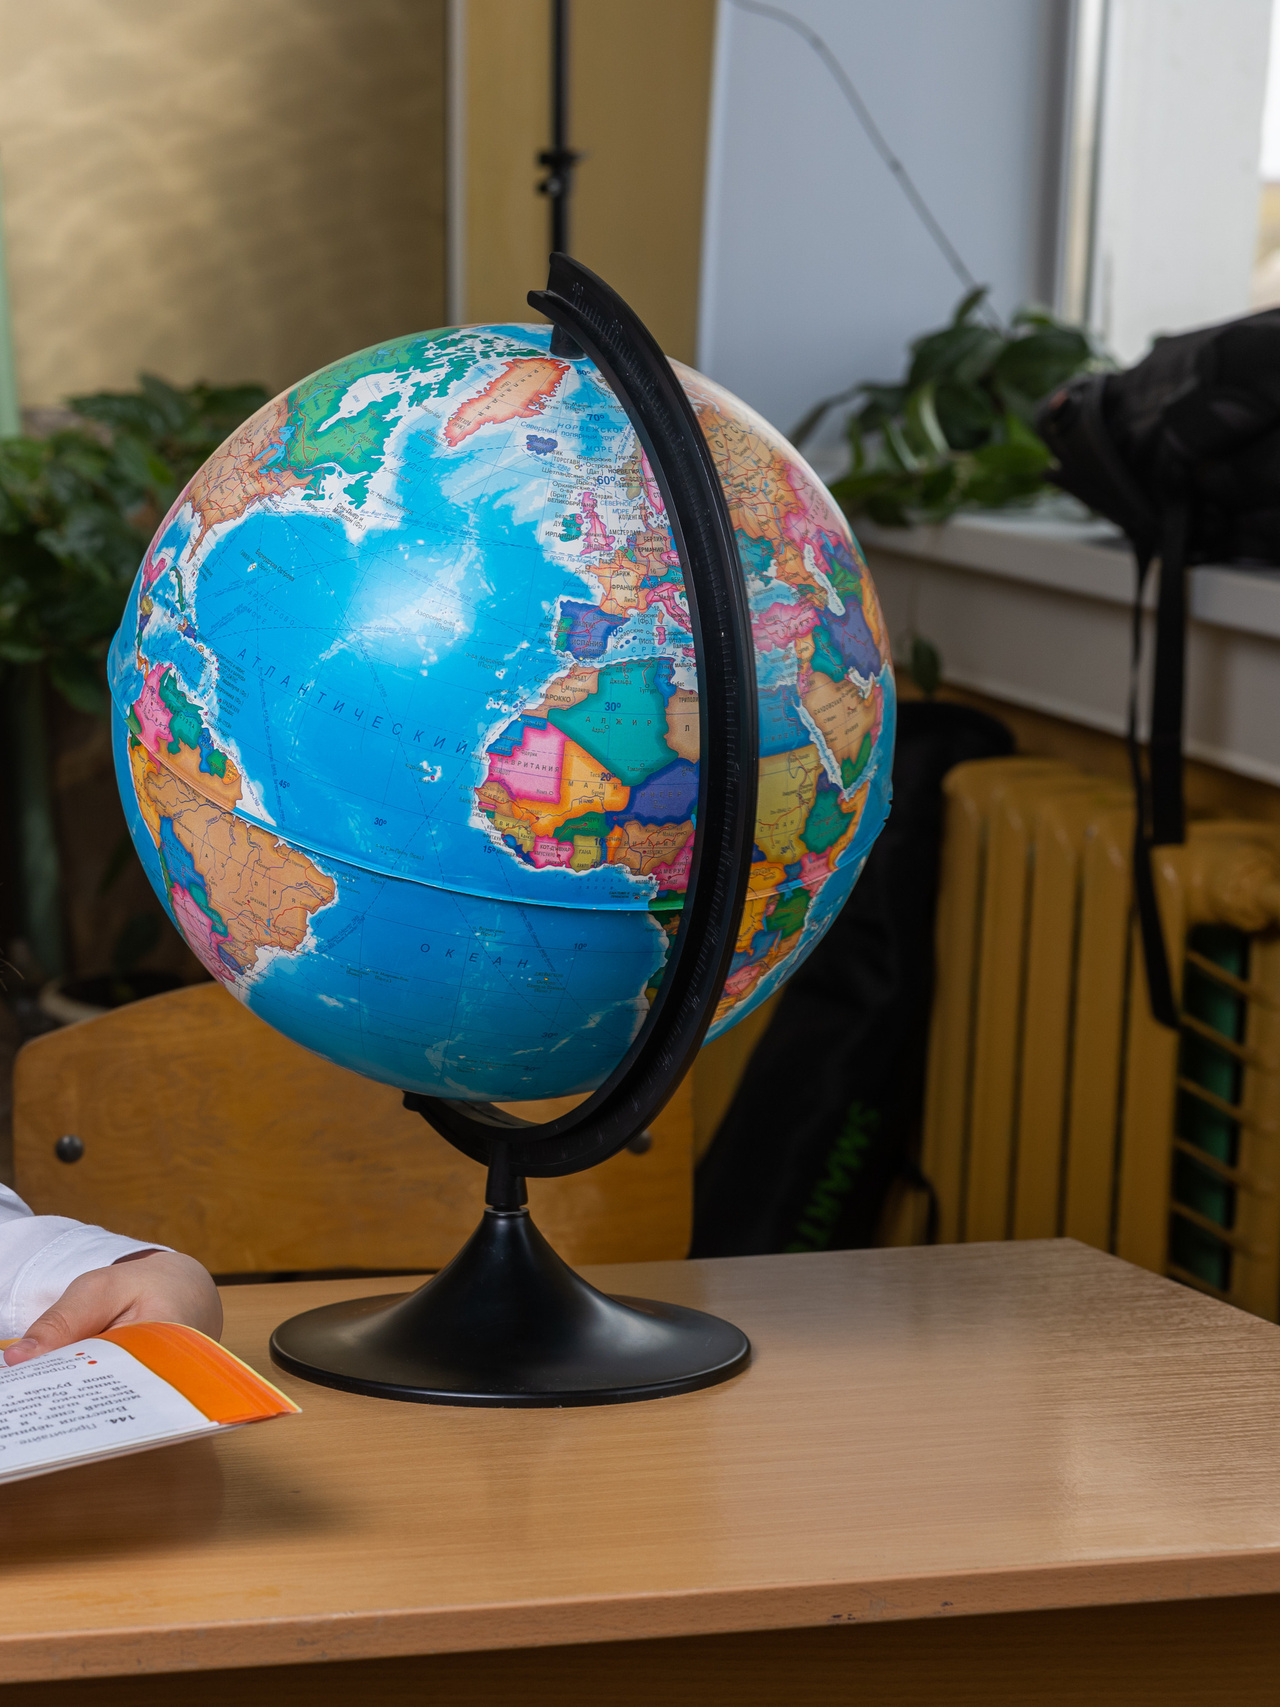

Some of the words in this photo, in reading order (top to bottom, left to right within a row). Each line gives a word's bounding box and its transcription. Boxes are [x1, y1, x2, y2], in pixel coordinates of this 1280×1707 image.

[586, 413, 605, 422] 70°
[585, 445, 613, 453] МОРЕ
[586, 461, 613, 469] Острова
[597, 475, 616, 485] 60°
[547, 497, 598, 509] ВЕЛИКОБРИТАНИЯ
[545, 531, 580, 541] ИРЛАНДИЯ
[571, 639, 603, 647] ИСПАНИЯ
[236, 647, 469, 756] АТЛАНТИЧЕСКИЙ
[539, 692, 571, 702] МАРОККО
[605, 701, 622, 711] 30°
[585, 716, 652, 726] АЛЖИР
[497, 756, 560, 773] МАВРИТАНИЯ
[600, 773, 616, 781] 20°
[279, 779, 290, 788] 45°
[568, 781, 619, 790] МАЛИ
[374, 818, 387, 827] 30°
[483, 845, 497, 854] 15°
[420, 943, 529, 969] ОКЕАН
[82, 1374, 115, 1385] звон
[23, 1381, 73, 1397] ручьёв
[77, 1379, 122, 1393] чинал
[111, 1384, 128, 1393] ей
[1, 1389, 69, 1408] булькать
[51, 1390, 103, 1405] только
[91, 1388, 136, 1403] Весна
[48, 1401, 81, 1413] шла
[83, 1394, 141, 1412] мокрый
[19, 1411, 39, 1419] по
[37, 1409, 75, 1421] снег,
[59, 1405, 128, 1426] Блестели
[104, 1414, 136, 1425] 144.
[0, 1423, 55, 1440] чёрные
[15, 1422, 97, 1446] Прочитайте.
